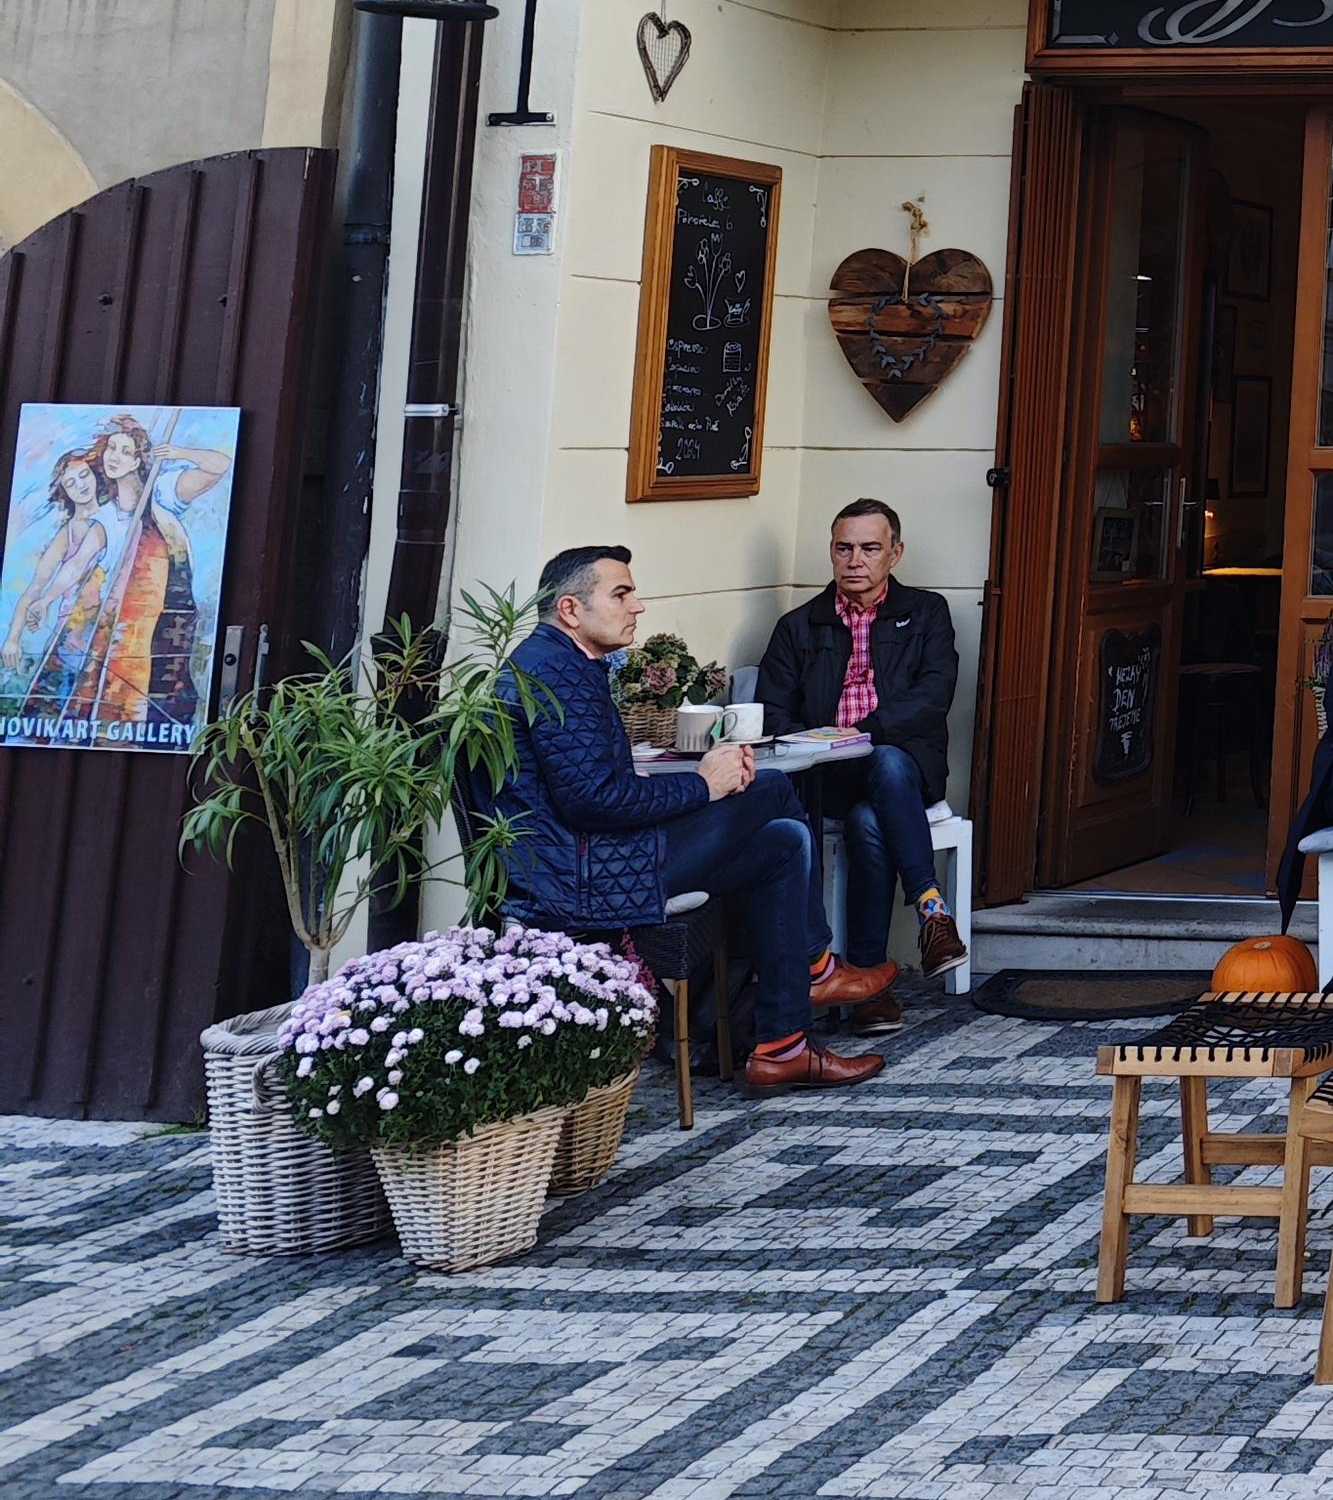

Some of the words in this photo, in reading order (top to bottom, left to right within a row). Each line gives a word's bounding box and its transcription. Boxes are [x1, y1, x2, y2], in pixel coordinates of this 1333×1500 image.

[1112, 688, 1136, 712] DEN
[61, 719, 101, 739] ART
[106, 721, 196, 746] GALLERY
